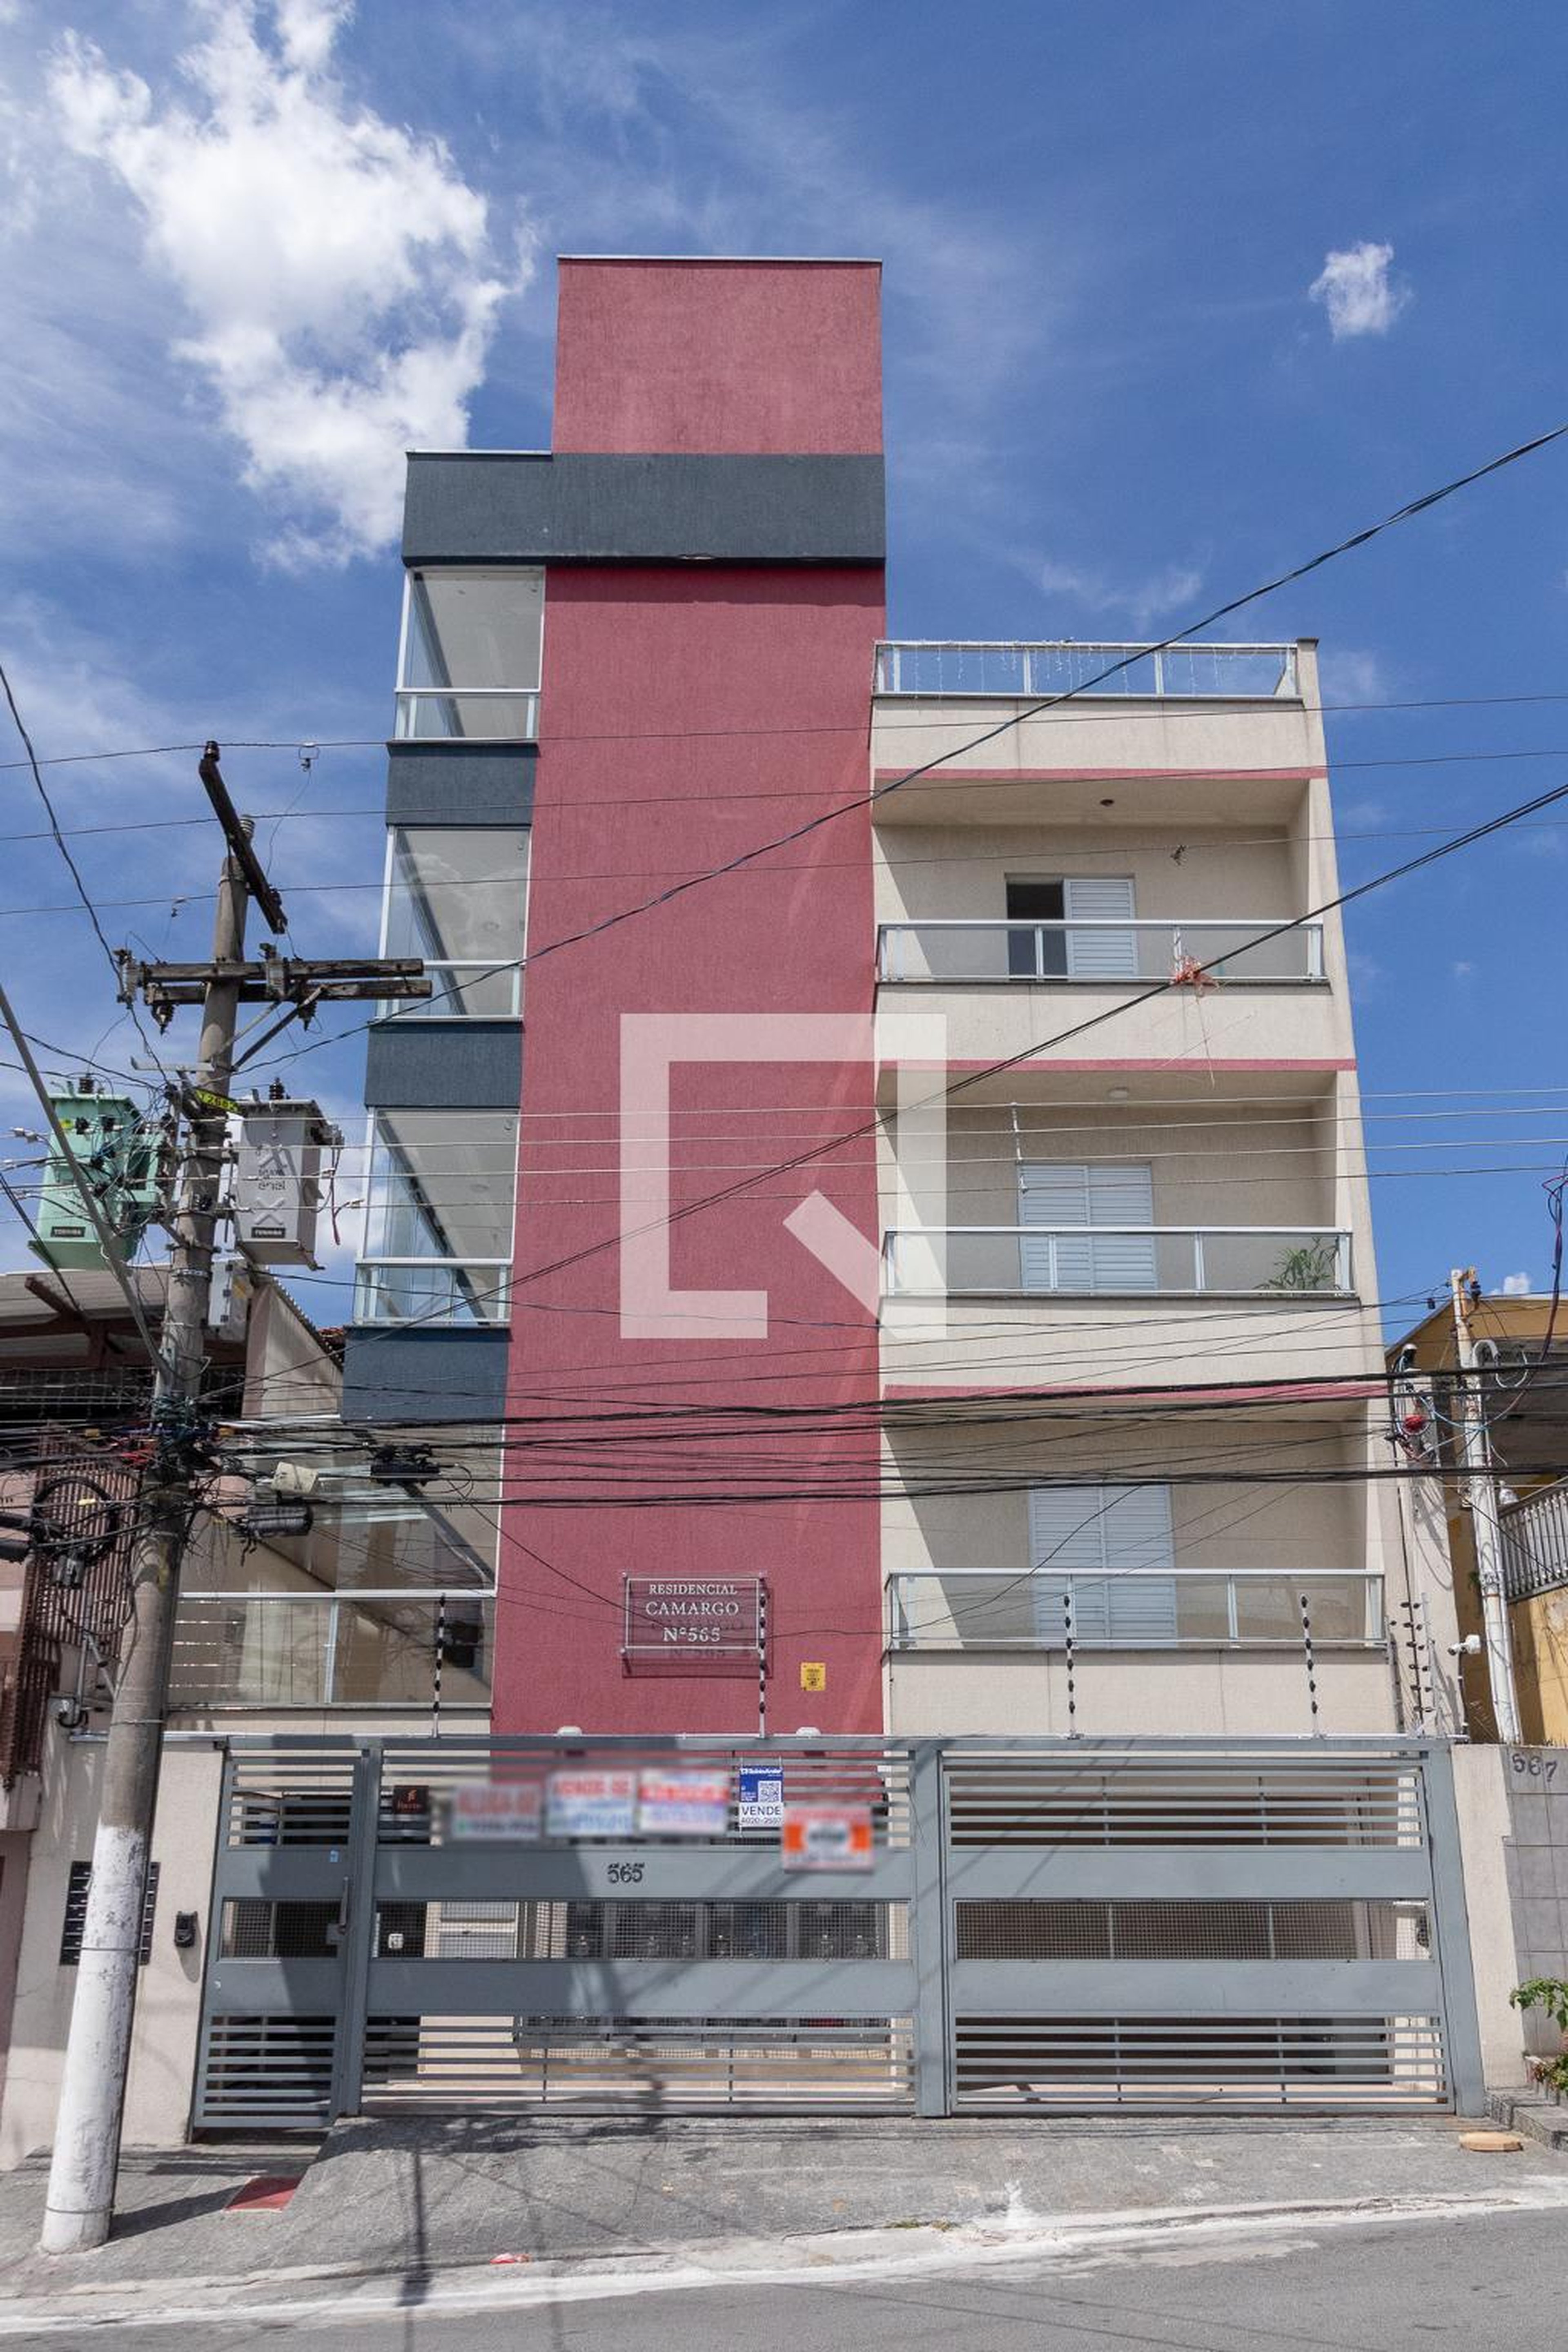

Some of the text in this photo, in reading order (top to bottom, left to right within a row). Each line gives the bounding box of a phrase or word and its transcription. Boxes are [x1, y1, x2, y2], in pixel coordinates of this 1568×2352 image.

[649, 1584, 738, 1595] RESIDENCIAL
[646, 1601, 739, 1616] CAMARGO
[1512, 1753, 1557, 1782] 567
[742, 1806, 781, 1815] VENDE
[607, 1862, 645, 1883] 565
